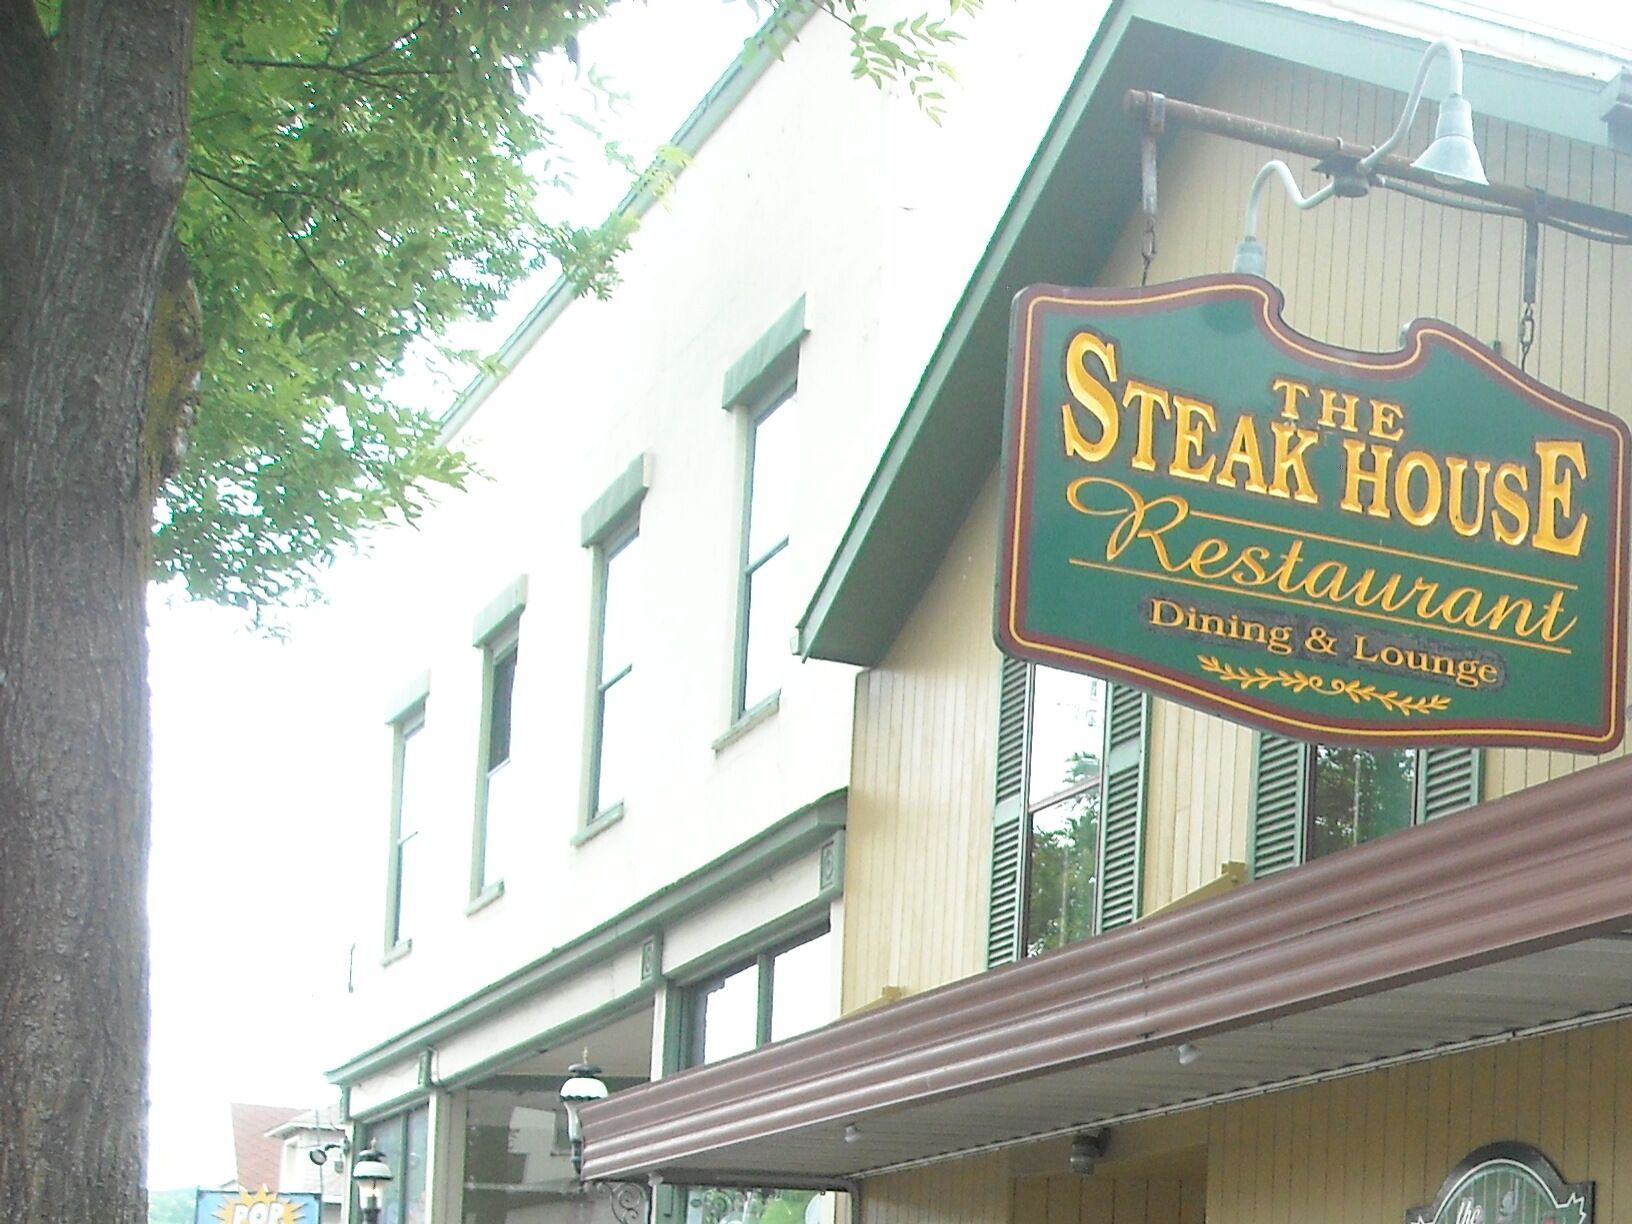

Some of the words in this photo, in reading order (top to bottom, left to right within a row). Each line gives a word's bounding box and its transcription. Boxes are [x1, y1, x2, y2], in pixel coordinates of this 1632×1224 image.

[1062, 332, 1318, 505] STEAK
[1341, 437, 1589, 557] HOUSE
[1272, 378, 1404, 441] THE
[1066, 476, 1579, 643] Restaurant
[1149, 599, 1292, 655] Dining
[1304, 628, 1338, 655] &
[1353, 634, 1498, 688] Lounge
